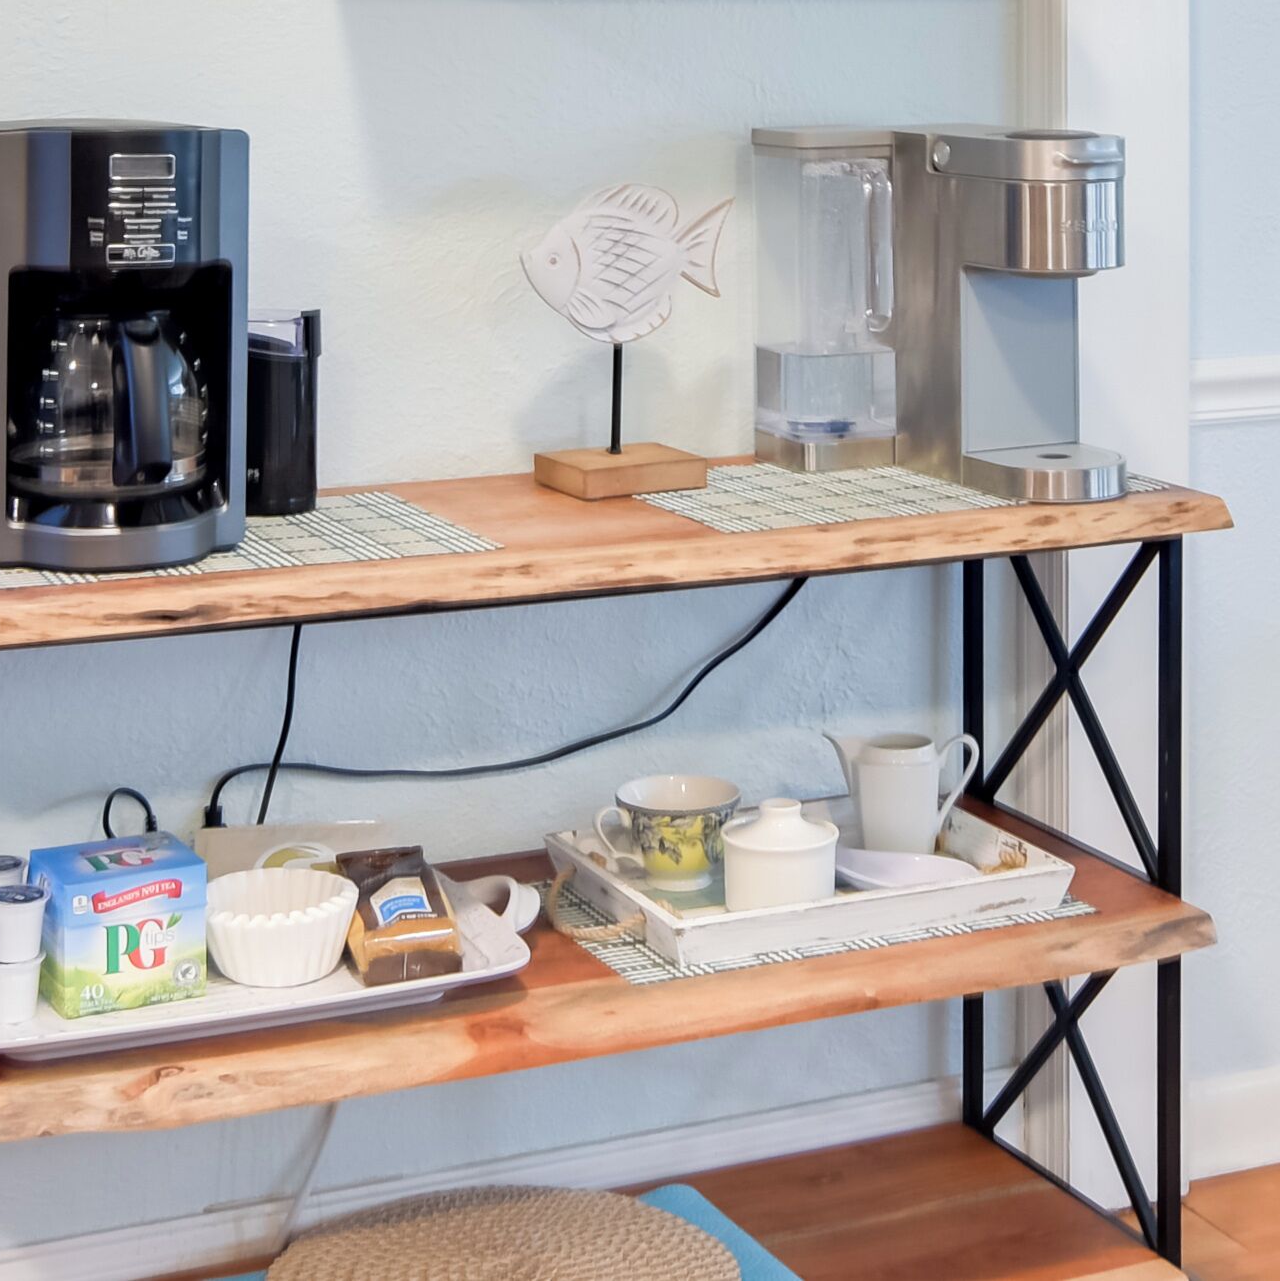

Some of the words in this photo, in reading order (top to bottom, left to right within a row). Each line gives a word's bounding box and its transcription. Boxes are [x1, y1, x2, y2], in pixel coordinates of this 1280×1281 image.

[144, 929, 176, 946] tips
[104, 918, 168, 976] PG
[80, 983, 105, 1001] 40
